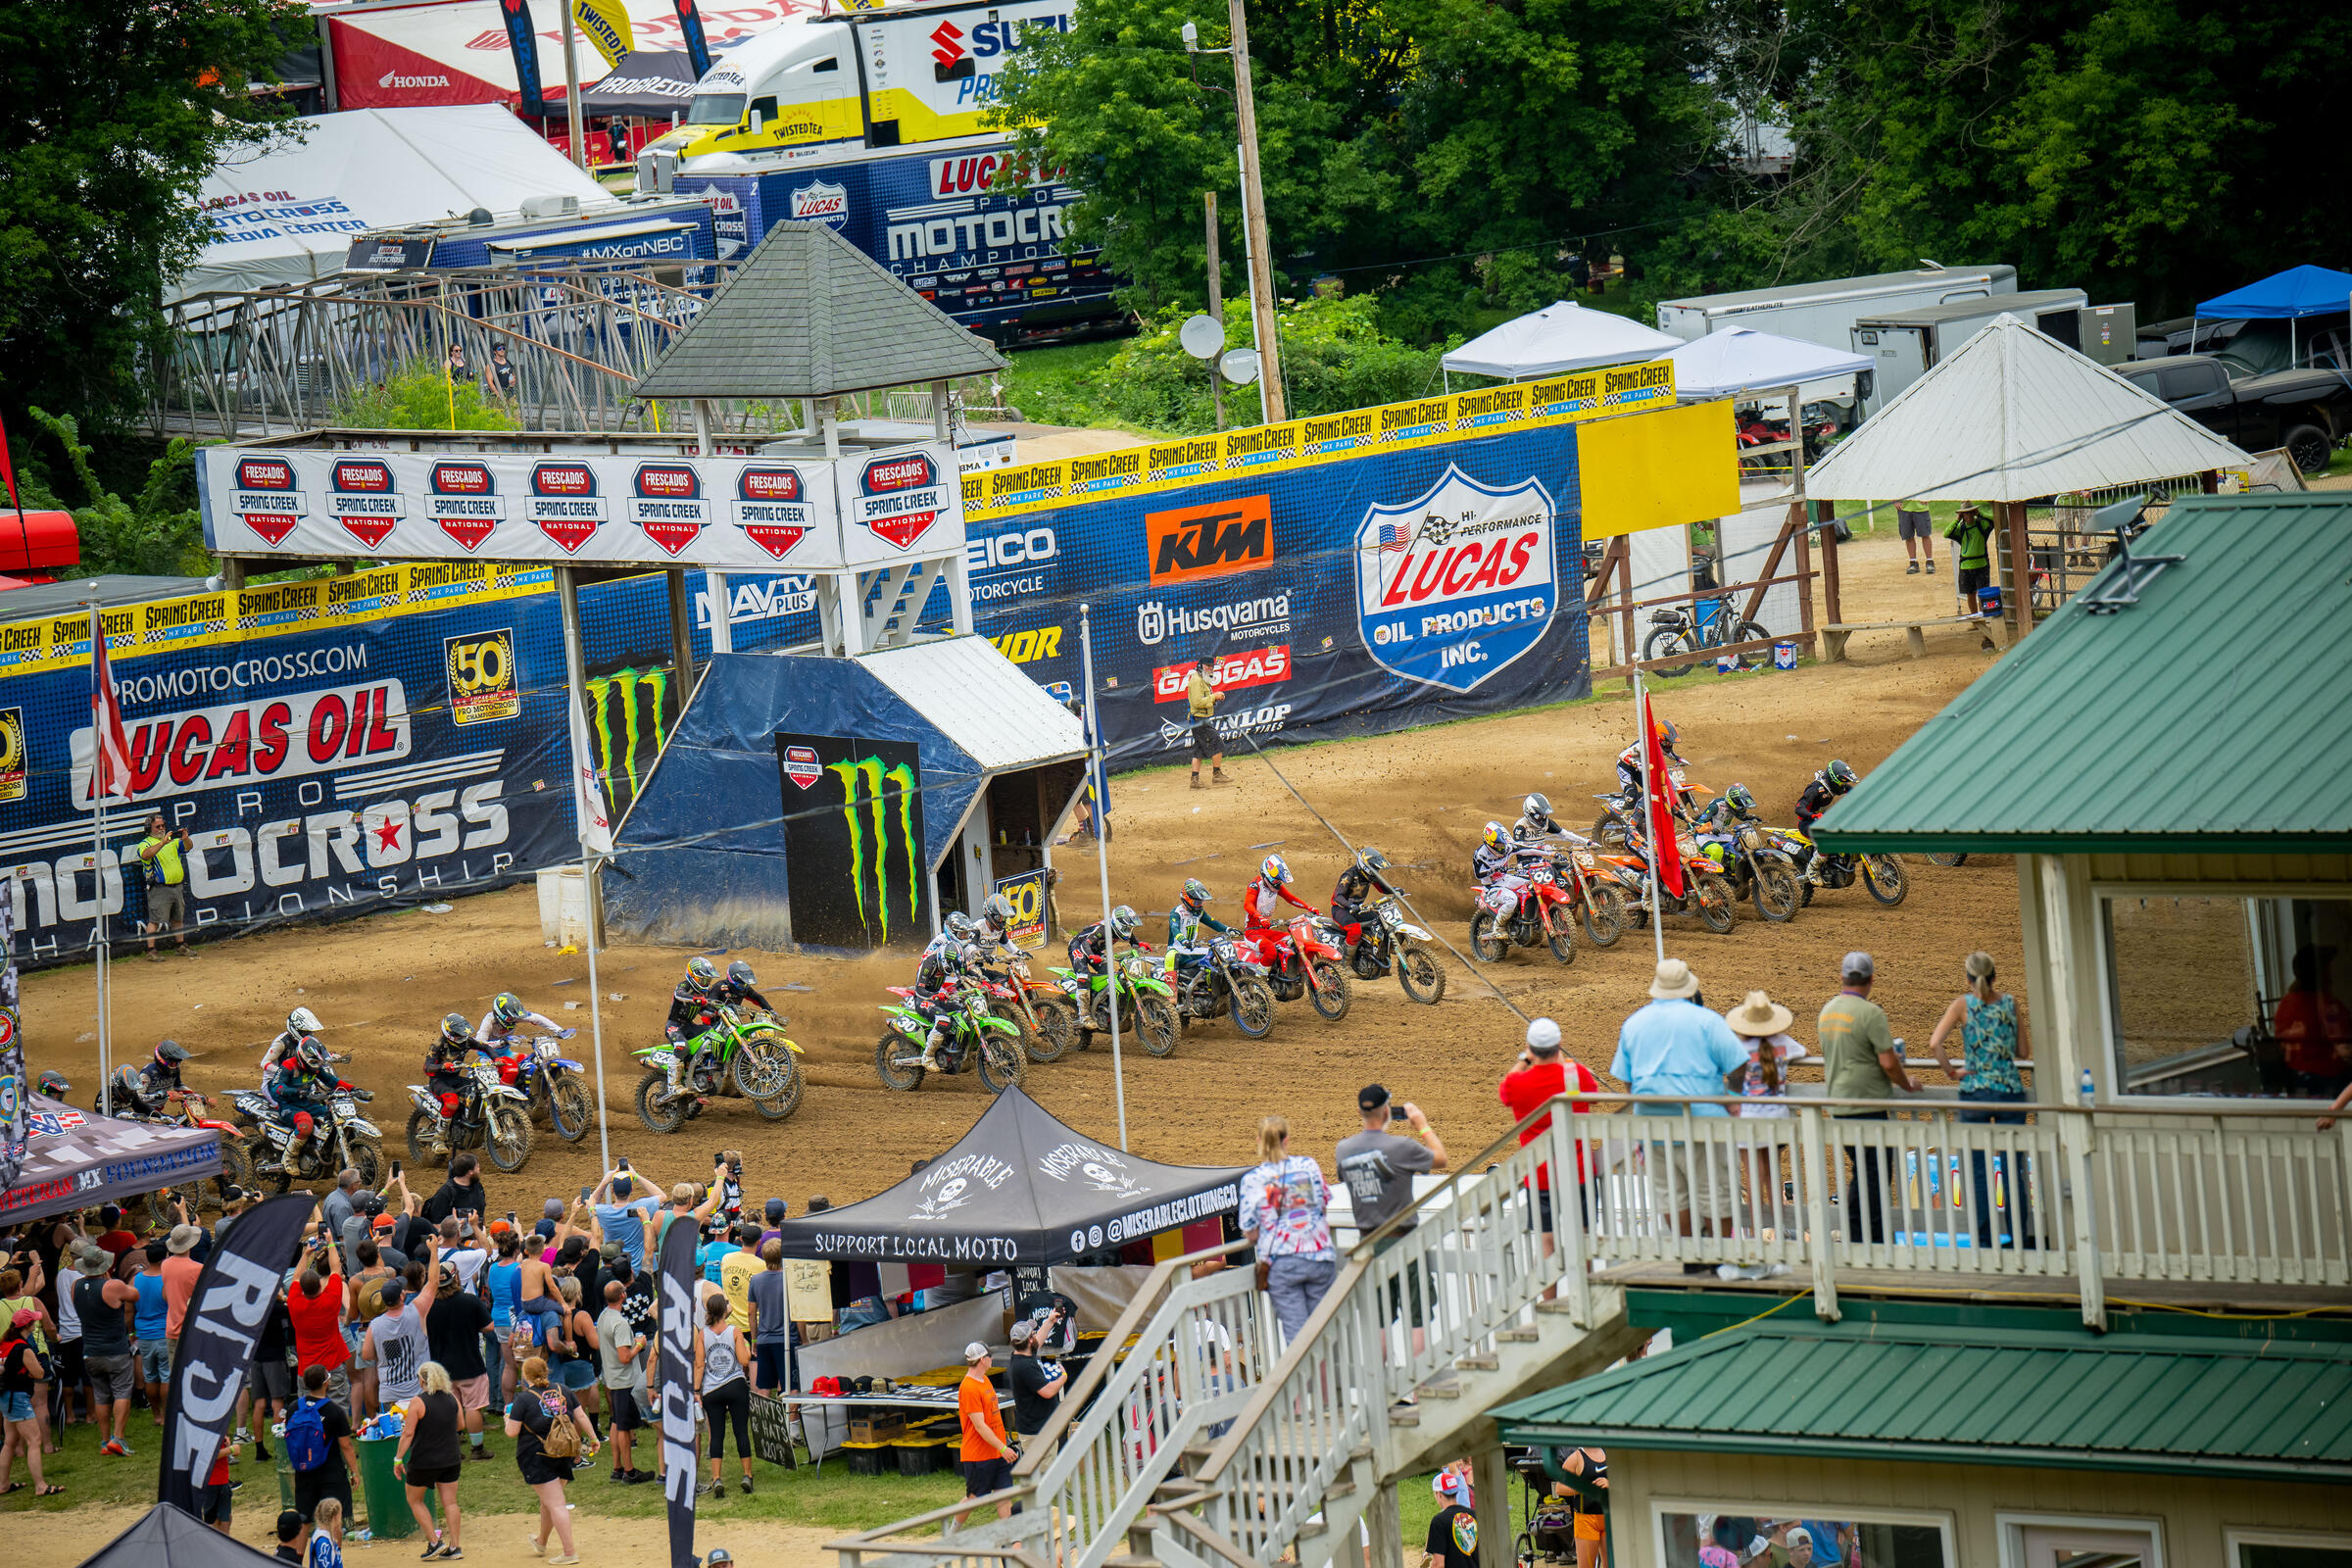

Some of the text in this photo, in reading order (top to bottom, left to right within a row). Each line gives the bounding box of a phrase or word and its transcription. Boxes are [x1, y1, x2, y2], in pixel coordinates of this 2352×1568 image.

[577, 1, 622, 50] TWISTED
[393, 75, 450, 88] HONDA
[727, 72, 745, 87] TEA
[773, 122, 823, 141] TWISTED TEA
[751, 181, 759, 196] 2
[200, 192, 261, 212] LUCAS
[264, 190, 296, 202] OIL
[719, 197, 733, 210] OIL
[798, 197, 842, 216] LUCAS
[196, 201, 350, 228] OTOCROSS
[282, 220, 369, 235] CENTER
[887, 204, 1066, 261] MOTOCR
[582, 236, 683, 259] #MXonNBC
[913, 276, 938, 288] WPS
[1605, 365, 1669, 393] SPRING CREEK
[1634, 389, 1651, 399] PARK
[1382, 402, 1448, 429] SPRING CREEK
[1412, 427, 1430, 436] PARK
[1227, 427, 1295, 457] SPRING CREEK
[245, 465, 285, 480] FRESCADOS
[440, 469, 483, 484] FRESCADOS
[645, 472, 689, 487] FRESCADOS
[873, 462, 923, 483] FRESCADOS
[993, 471, 1028, 494] SPRING
[1030, 466, 1061, 488] CREEK
[239, 495, 298, 511] SPRING CREEK
[865, 491, 938, 516] SPRING CREEK
[1024, 491, 1042, 500] PARK
[434, 500, 497, 515] SPRING CREEK
[638, 503, 702, 519] SPRING CREEK
[250, 515, 292, 524] NATIONAL
[445, 520, 490, 529] NATIONAL
[877, 514, 930, 528] NATIONAL
[1461, 514, 1542, 536] PERFORMANCE
[966, 527, 1056, 571] EICO
[1154, 512, 1266, 574] KTM
[410, 566, 450, 588] SPRING
[451, 563, 485, 584] CREEK
[1381, 531, 1540, 607] LUCAS
[445, 586, 464, 596] PARK
[968, 575, 1043, 603] OTORCYCLE
[238, 586, 318, 615] SPRING CREEK
[775, 593, 809, 613] PLUS
[146, 598, 224, 629] SPRING CREEK
[1168, 594, 1290, 636] Husqvarna
[1374, 597, 1546, 646] OIL PRODUCTS
[182, 626, 202, 635] PARK
[1230, 622, 1291, 641] MOTORCYCLES
[990, 625, 1062, 664] HOR
[458, 640, 507, 691] 50
[458, 701, 515, 716] PRO MOTOCROSS
[466, 709, 509, 720] CHAMPIONSHIP
[306, 685, 398, 765] OIL
[174, 781, 322, 826] PRO
[0, 780, 511, 931] MOOCROSS
[1533, 870, 1554, 885] 96
[1004, 882, 1039, 927] 50
[1384, 908, 1402, 922] 24
[1301, 926, 1308, 940] 1
[1220, 943, 1237, 959] 32
[897, 1016, 917, 1033] 30
[78, 1167, 103, 1192] MX
[105, 1143, 219, 1186] FOUNDATION
[918, 1152, 1015, 1193] MISERABLE
[1039, 1143, 1127, 1183] MISERABLE
[1107, 1183, 1239, 1244] @MISERABLECLOTHINGCO
[814, 1232, 1019, 1262] SUPPORT LOCAL MOTO
[1016, 1266, 1042, 1279] SUPPORT
[1021, 1280, 1041, 1293] LOCAL
